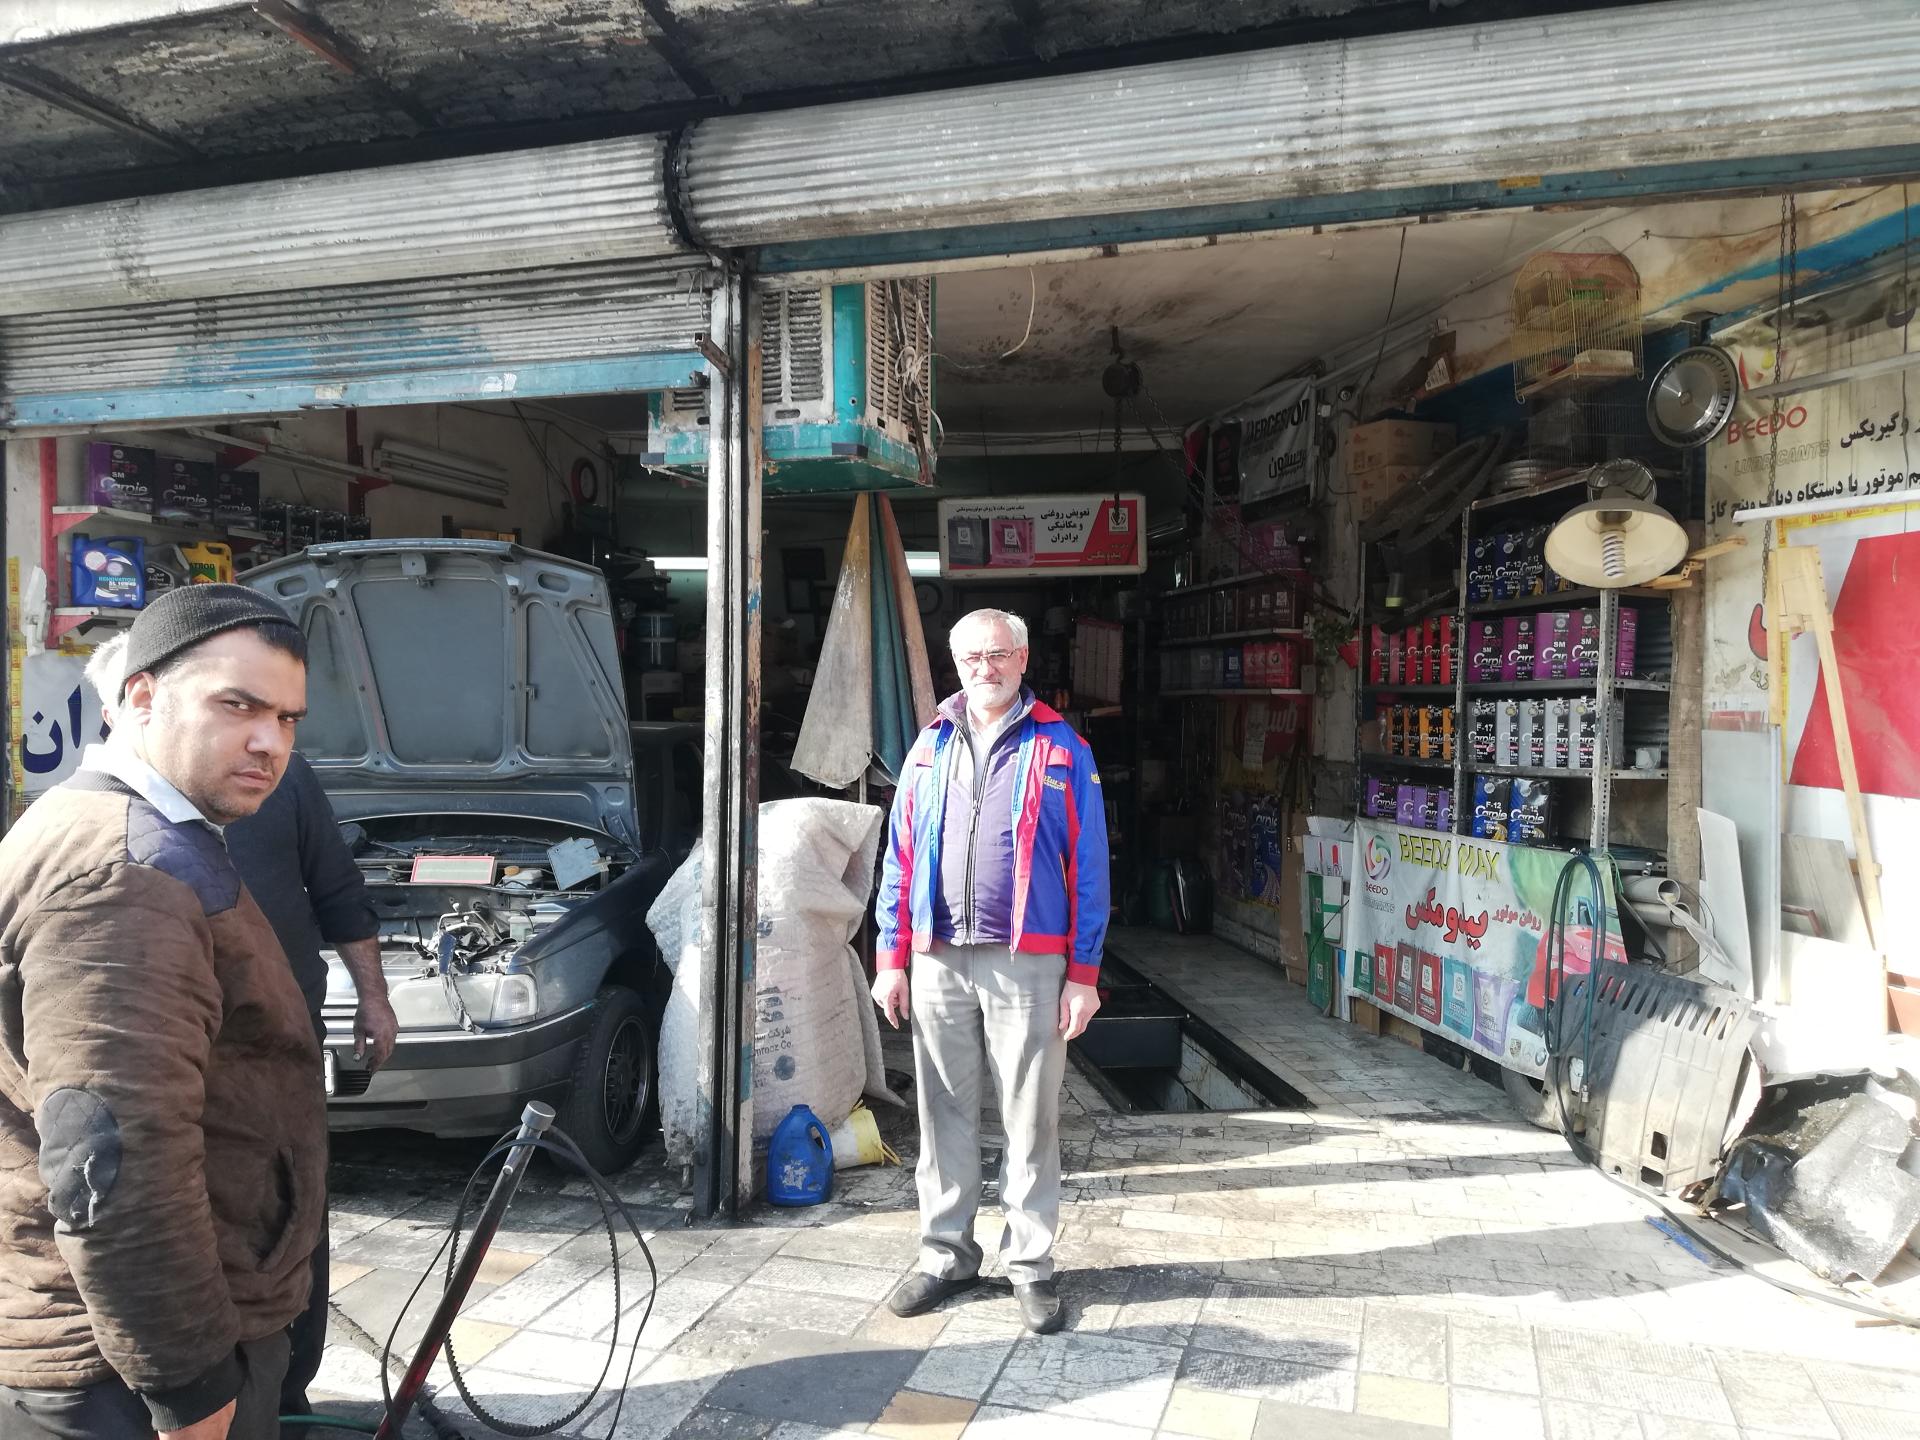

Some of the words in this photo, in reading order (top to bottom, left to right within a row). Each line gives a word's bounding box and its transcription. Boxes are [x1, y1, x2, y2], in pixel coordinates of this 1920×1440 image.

[1727, 405, 1808, 445] BEEDO
[1066, 507, 1090, 519] تعویض
[1047, 520, 1077, 532] مکانیکی
[1078, 523, 1084, 531] و
[1051, 532, 1079, 543] برادران
[1571, 645, 1599, 662] Carp
[1476, 723, 1493, 732] F-17
[1580, 724, 1596, 733] F-1
[1486, 801, 1501, 809] F-12
[1475, 805, 1508, 820] Carpie
[1511, 809, 1544, 825] Carpie
[1398, 833, 1452, 872] BEEDO
[1457, 843, 1501, 882] MAX
